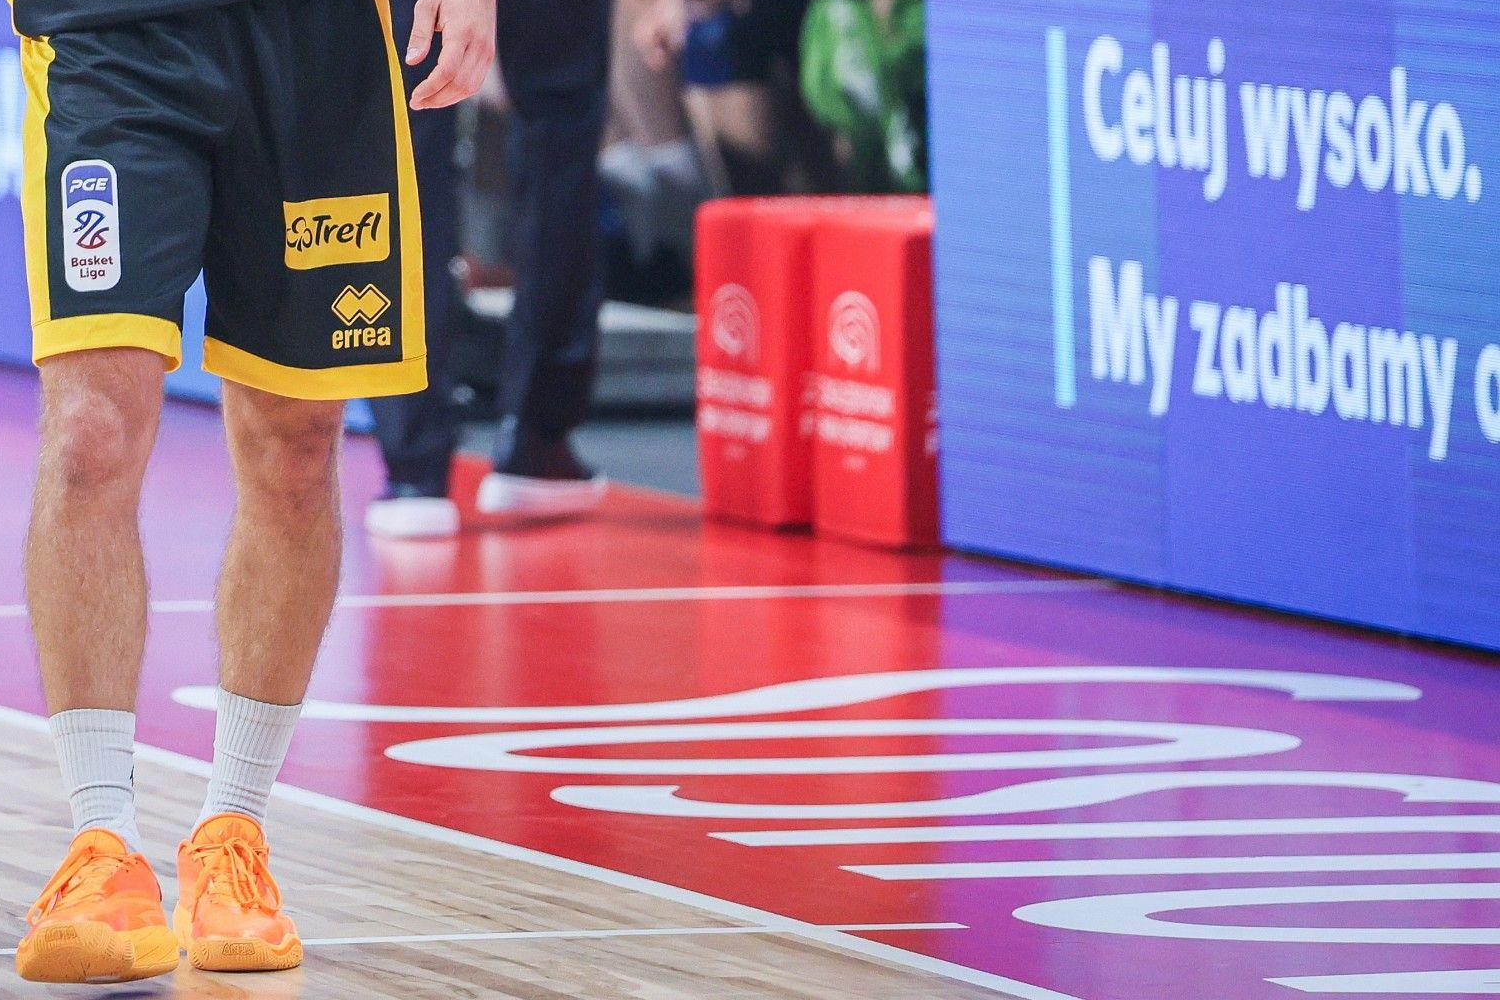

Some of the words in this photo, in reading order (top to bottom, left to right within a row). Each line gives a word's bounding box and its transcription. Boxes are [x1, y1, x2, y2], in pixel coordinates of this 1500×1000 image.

[1082, 35, 1228, 202] Celuj
[1238, 66, 1482, 211] wysoko.
[69, 177, 108, 193] PGE
[312, 211, 381, 249] Trefl
[71, 255, 114, 267] Basket
[80, 267, 106, 280] Liga
[1088, 256, 1179, 417] My
[1188, 281, 1458, 461] zadbamy
